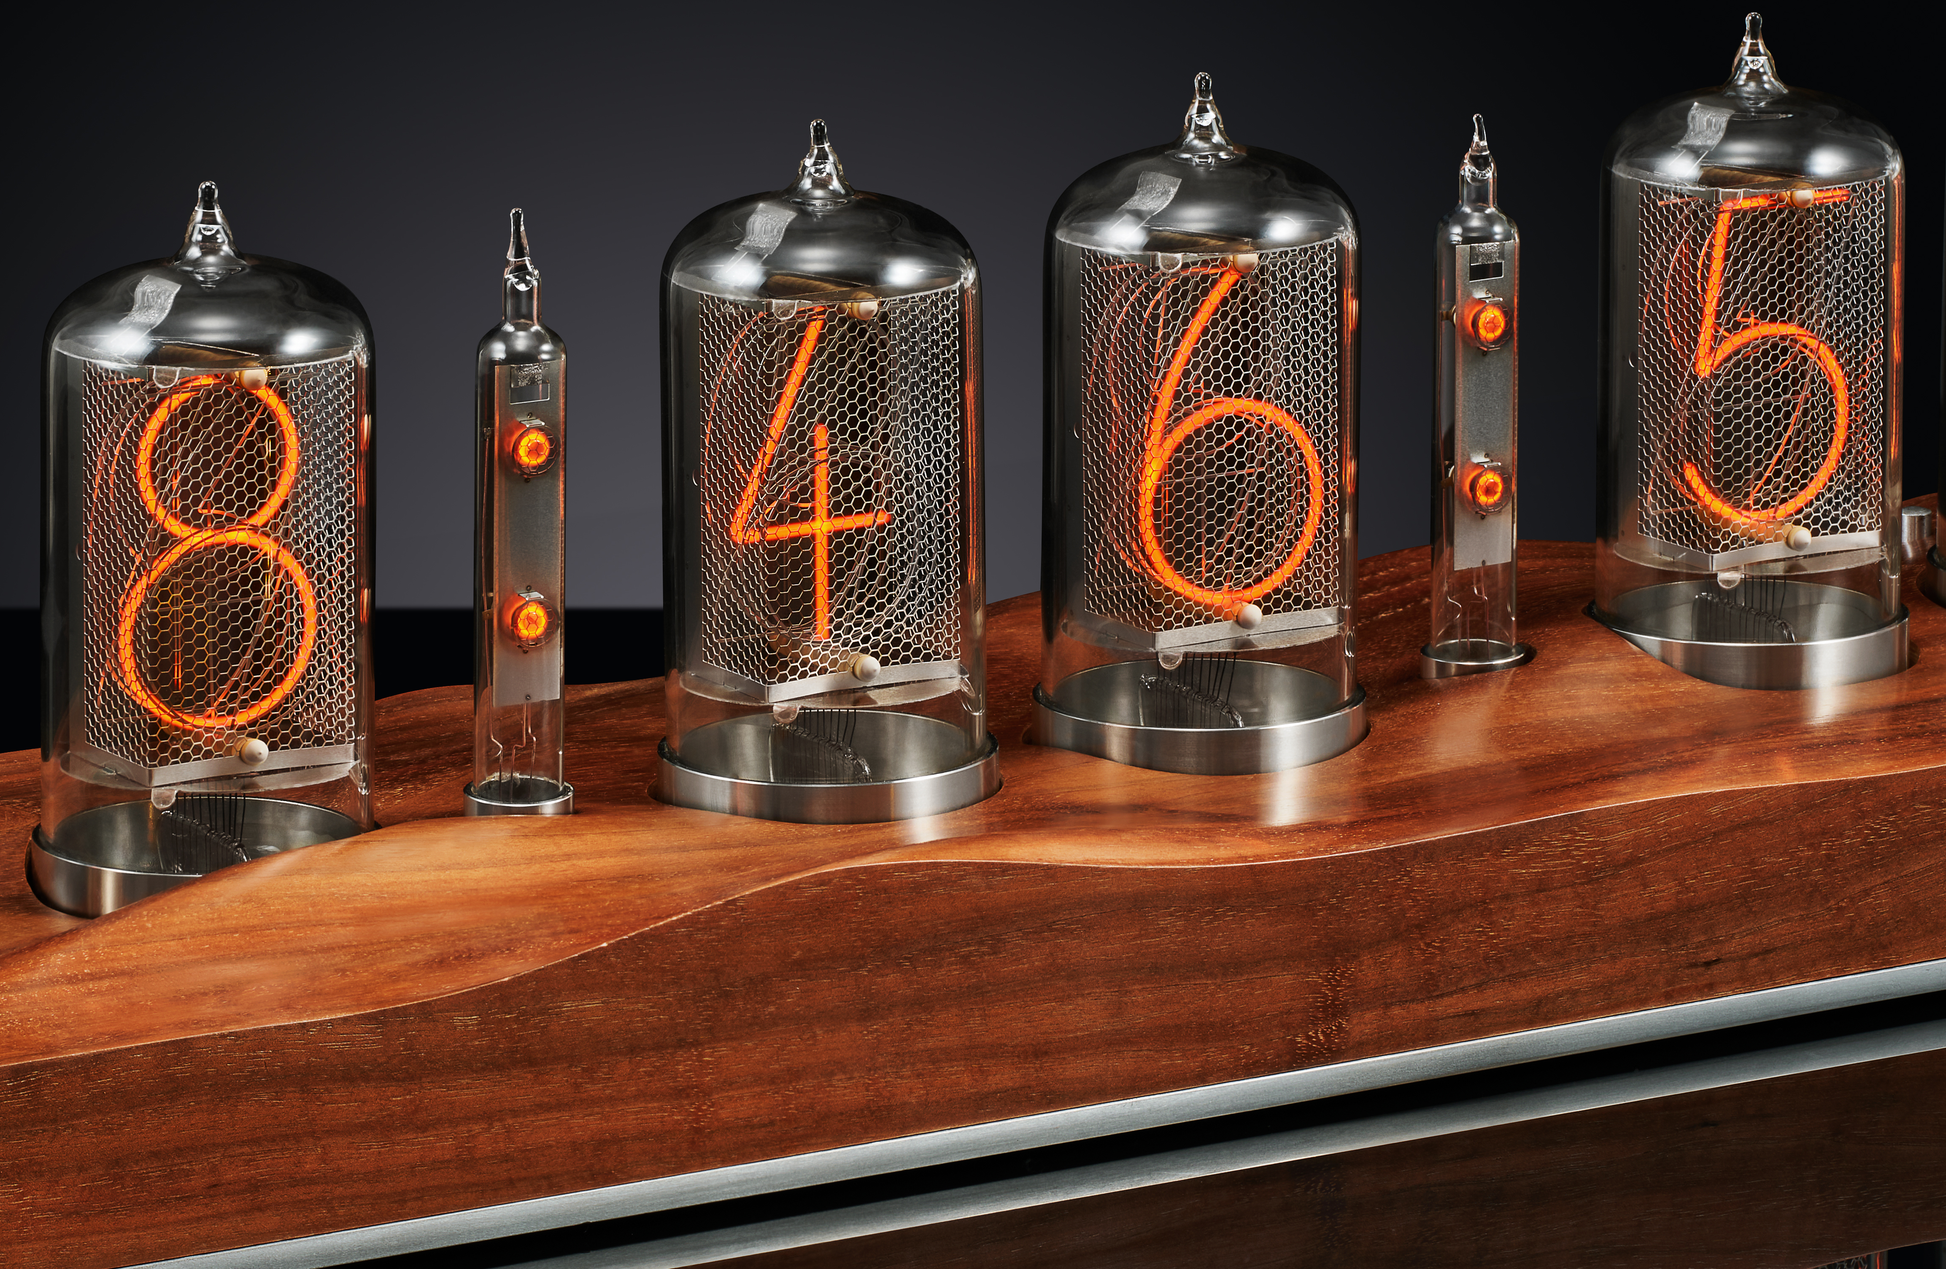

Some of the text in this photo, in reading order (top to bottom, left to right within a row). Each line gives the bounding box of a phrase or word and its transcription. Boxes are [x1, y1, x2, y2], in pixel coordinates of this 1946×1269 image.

[118, 188, 1852, 732] 8 4 6 5
